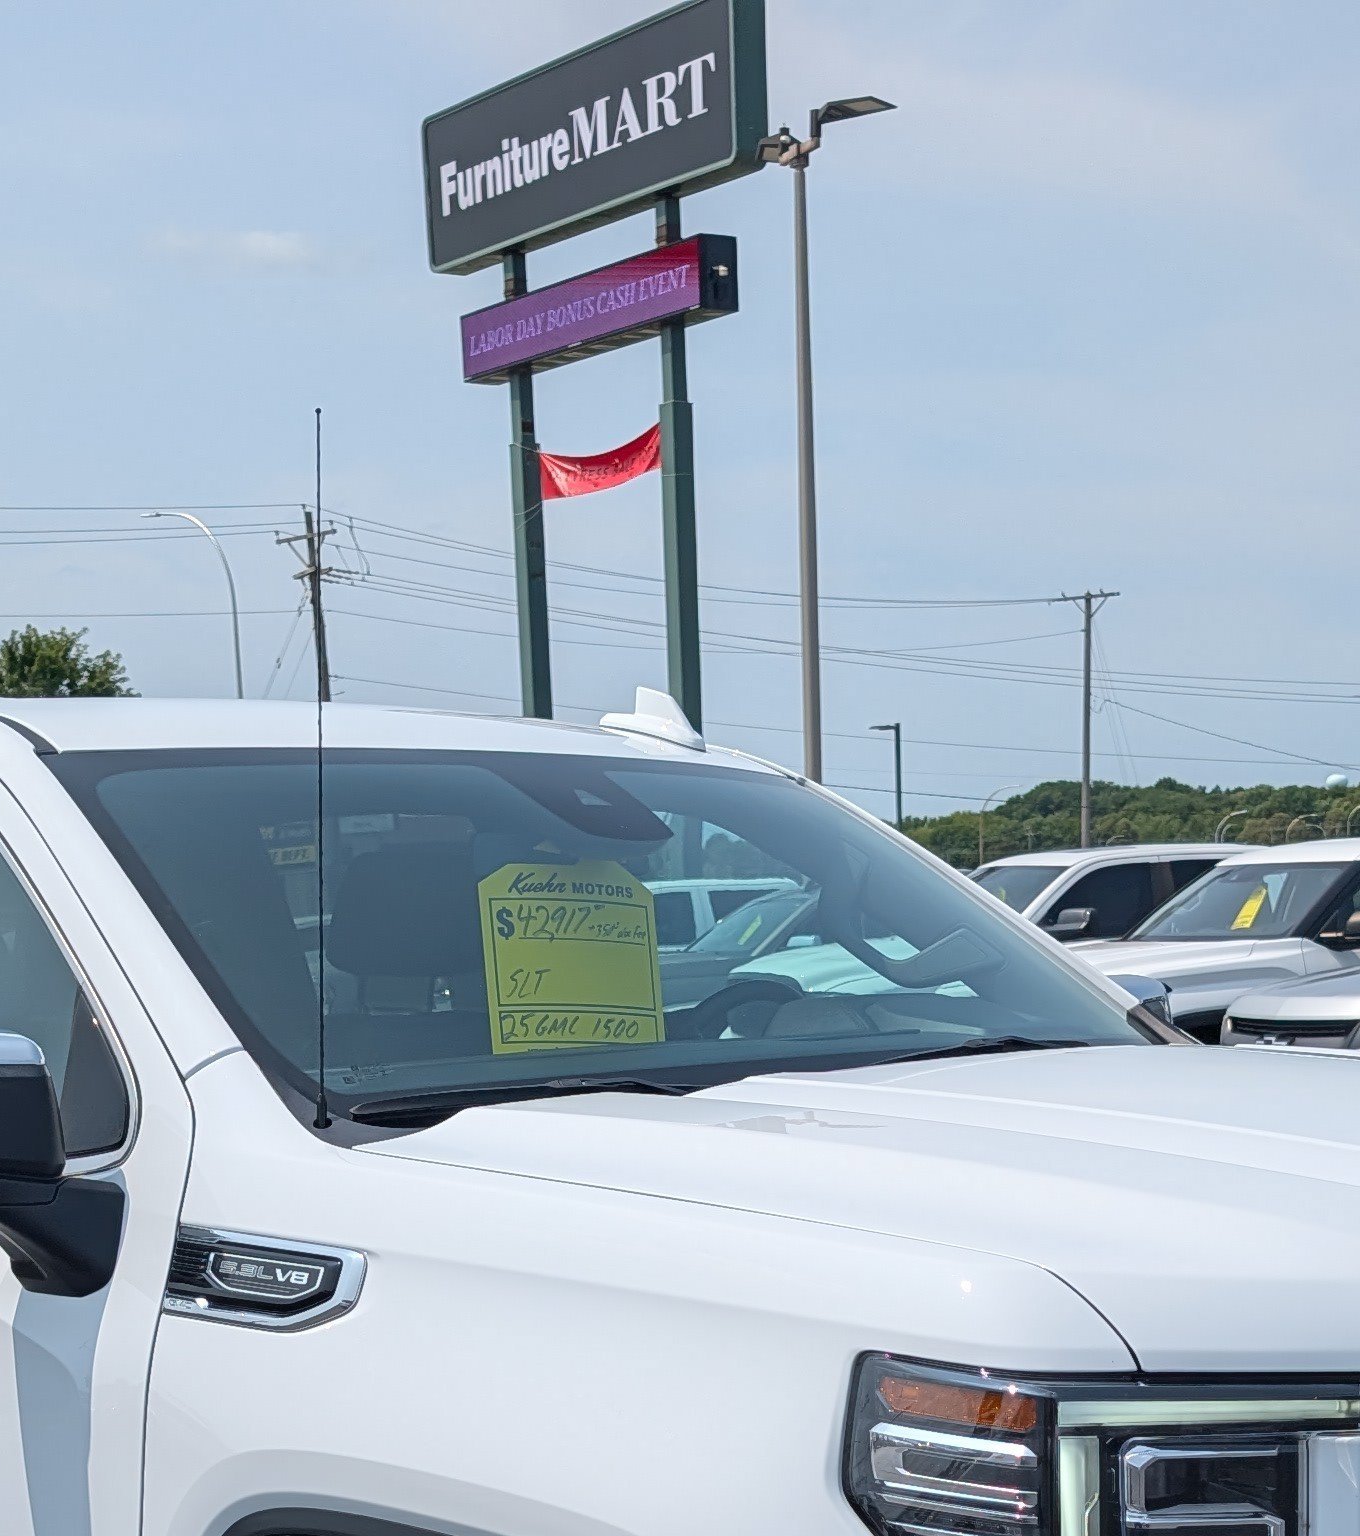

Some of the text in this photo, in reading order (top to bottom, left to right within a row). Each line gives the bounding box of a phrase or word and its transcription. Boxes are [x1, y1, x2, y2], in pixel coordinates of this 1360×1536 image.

[469, 265, 691, 357] LABOR DAY BONUS CASH EVENT
[508, 872, 634, 898] Kuehn MOTORS
[506, 968, 552, 998] SLT
[501, 1013, 639, 1041] 25 GMC 1500
[218, 1260, 309, 1285] 5.3L V8
